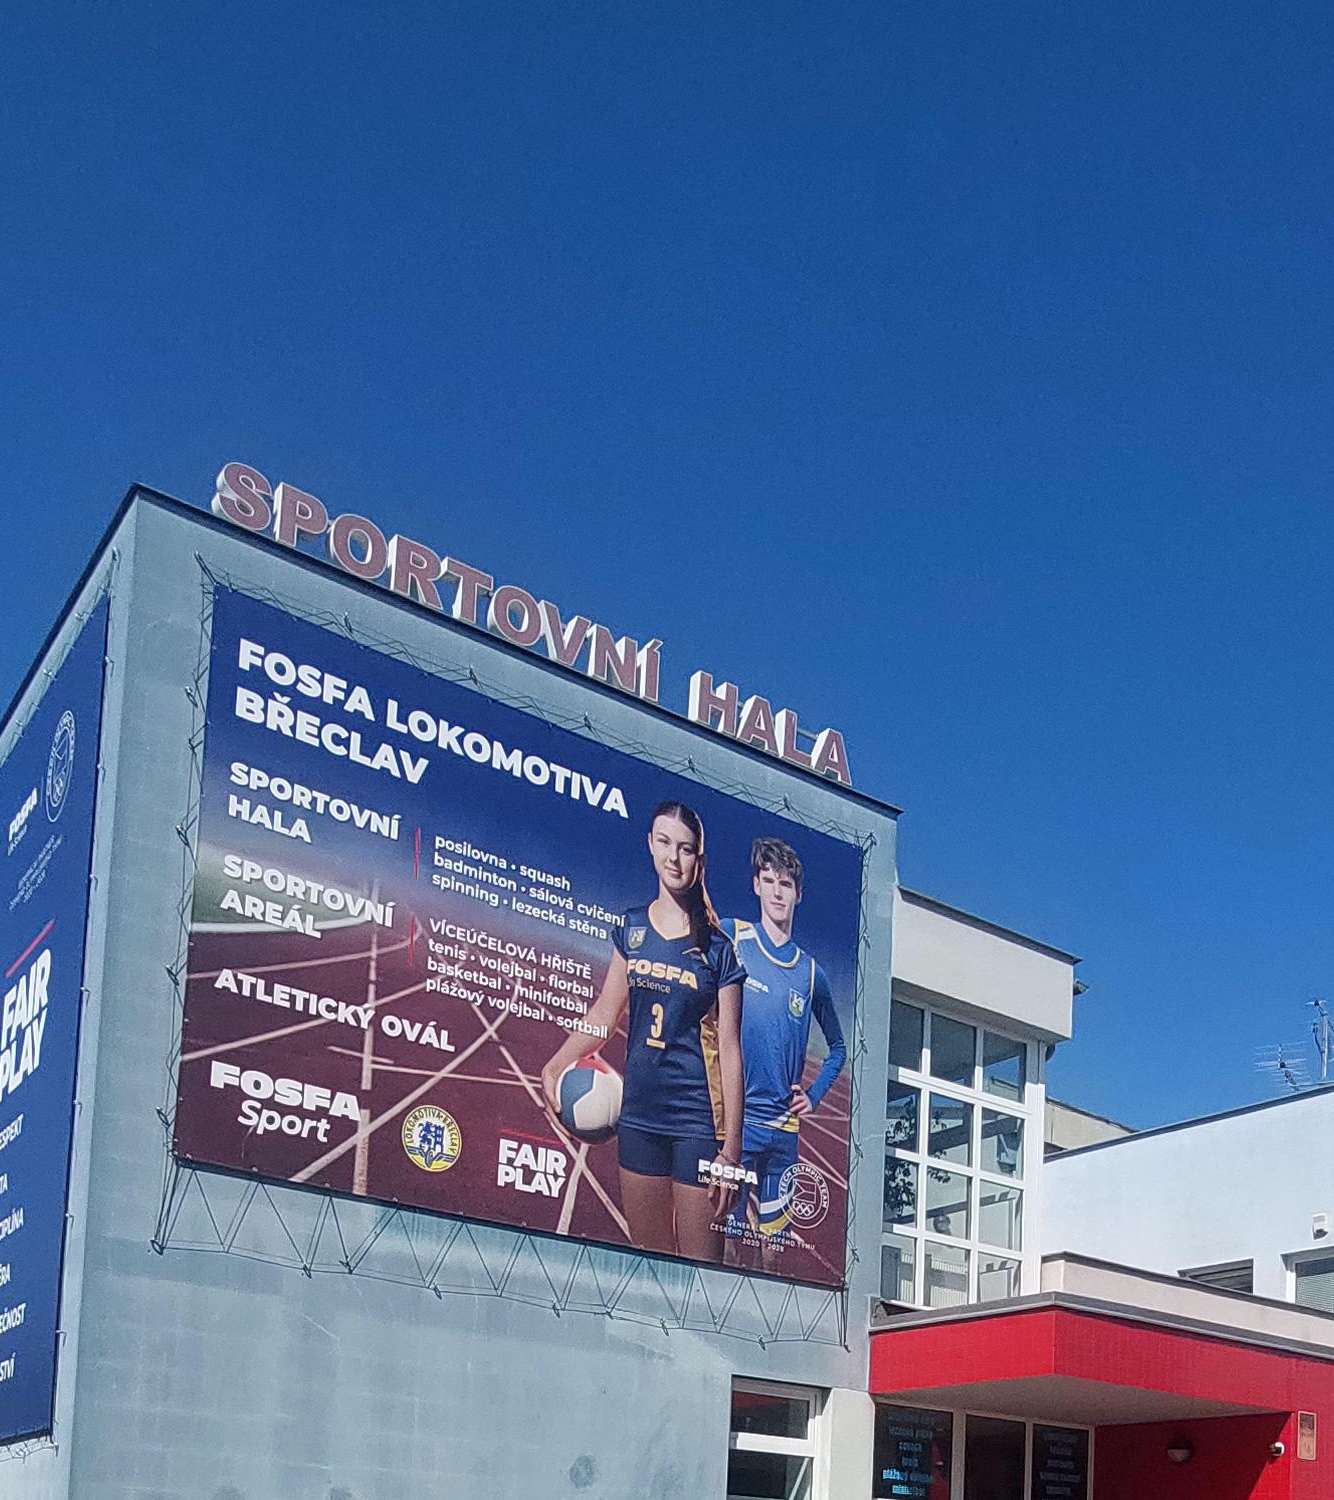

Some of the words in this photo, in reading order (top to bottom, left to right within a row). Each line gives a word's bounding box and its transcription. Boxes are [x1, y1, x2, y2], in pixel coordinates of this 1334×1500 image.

[211, 461, 663, 702] SPORTOVNÍ
[689, 670, 853, 785] HALA
[234, 684, 430, 785] BŘECLAV
[238, 637, 375, 723] FOSFA
[386, 697, 630, 819] LOKOMOTIVA
[227, 794, 312, 845] HALA
[229, 761, 399, 841] SPORTOVNÍ
[223, 854, 393, 928] SPORTOVNÍ
[434, 852, 517, 892] badminton
[529, 885, 573, 910] sálová
[577, 903, 625, 928] cvičení
[435, 836, 507, 870] posilovna
[519, 864, 571, 891] squash
[220, 886, 322, 939] AREÁL
[432, 873, 499, 907] spinning
[512, 897, 565, 926] lezecká
[569, 917, 607, 940] stěna
[429, 918, 537, 964] VÍCEÚČELOVÁ
[541, 953, 592, 979] HŘIŠTĚ
[429, 939, 467, 961] tenis
[479, 954, 536, 982] volejbal
[549, 974, 594, 999] florbal
[0, 948, 52, 1051] FAIR
[214, 967, 375, 1030] ATLETICKÝ
[381, 1010, 455, 1053] OVÁL
[426, 978, 485, 1006] plážový
[488, 996, 545, 1021] volejbal
[556, 1015, 608, 1039] softball
[428, 957, 501, 990] basketbal
[515, 984, 588, 1015] minifotbal
[637, 977, 671, 993] Science
[651, 1003, 665, 1038] 3
[209, 1060, 361, 1122] FOSFA
[237, 1098, 331, 1145] Sport
[497, 1163, 566, 1198] PLAY
[499, 1138, 567, 1176] FAIR
[698, 1159, 758, 1185] FOSFA
[792, 1165, 822, 1183] OLYMPIC
